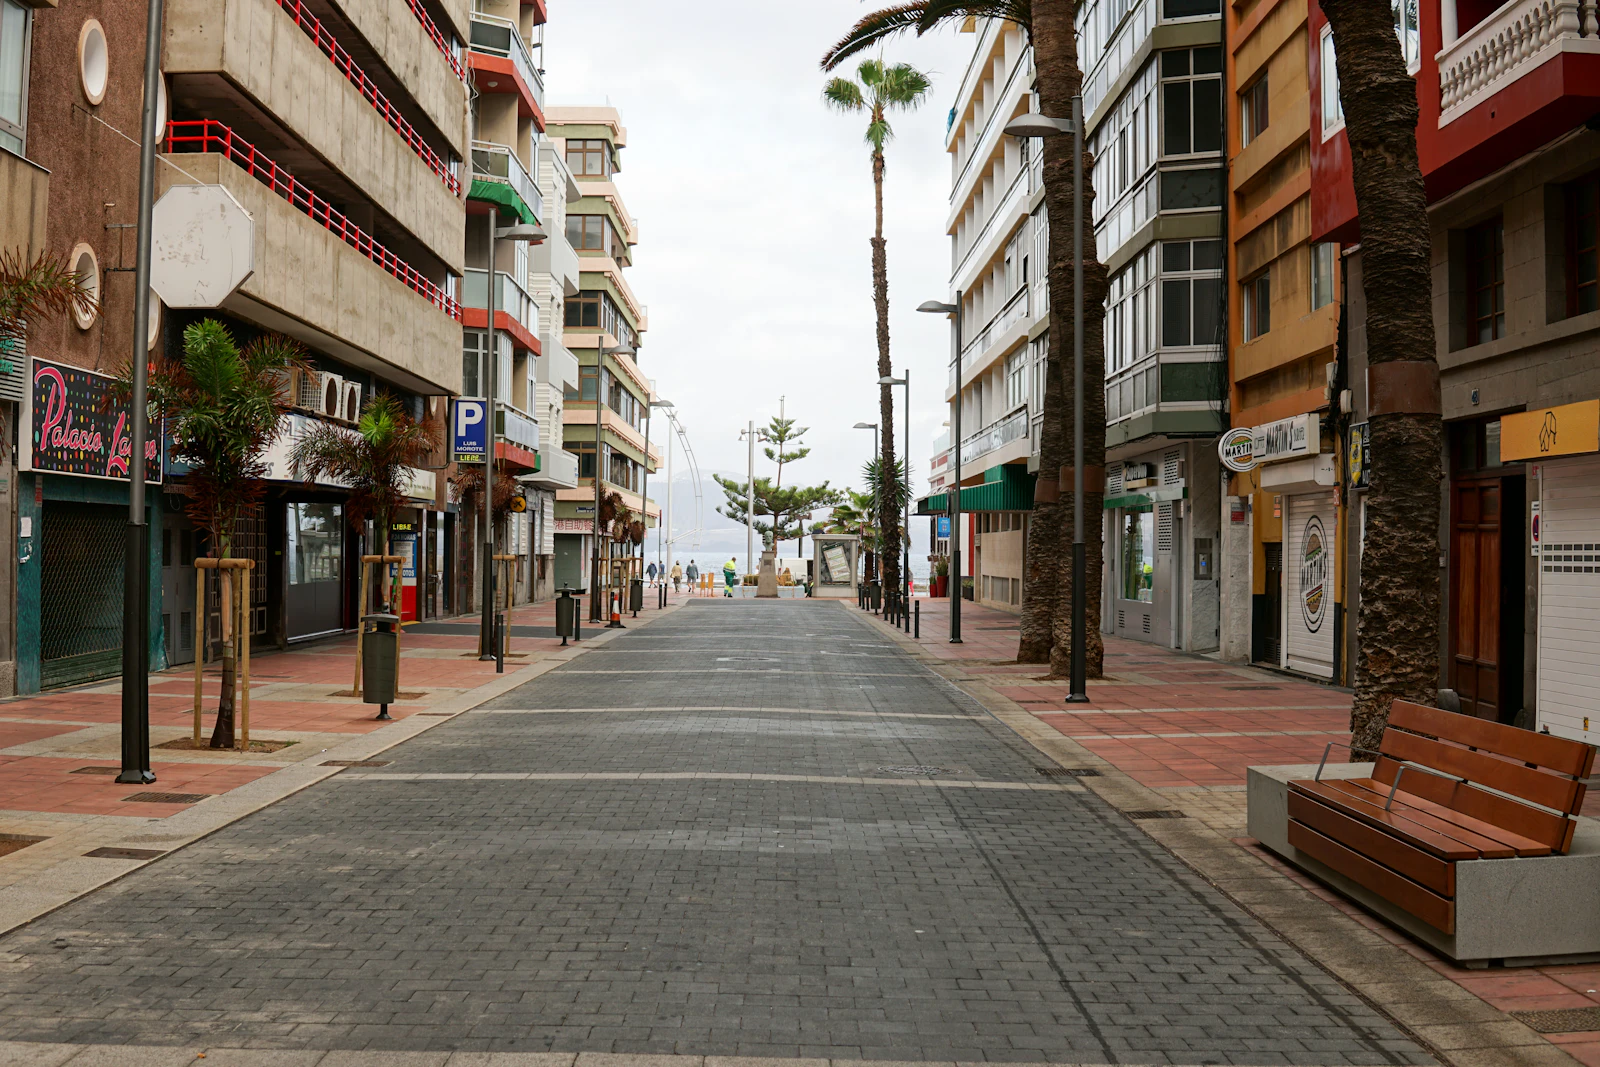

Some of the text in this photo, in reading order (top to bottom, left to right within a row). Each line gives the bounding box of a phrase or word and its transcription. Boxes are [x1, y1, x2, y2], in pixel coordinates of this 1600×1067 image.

[34, 366, 103, 452] Palacio
[457, 401, 484, 437] P
[392, 523, 412, 531] LIBRE
[402, 569, 414, 577] OTOS
